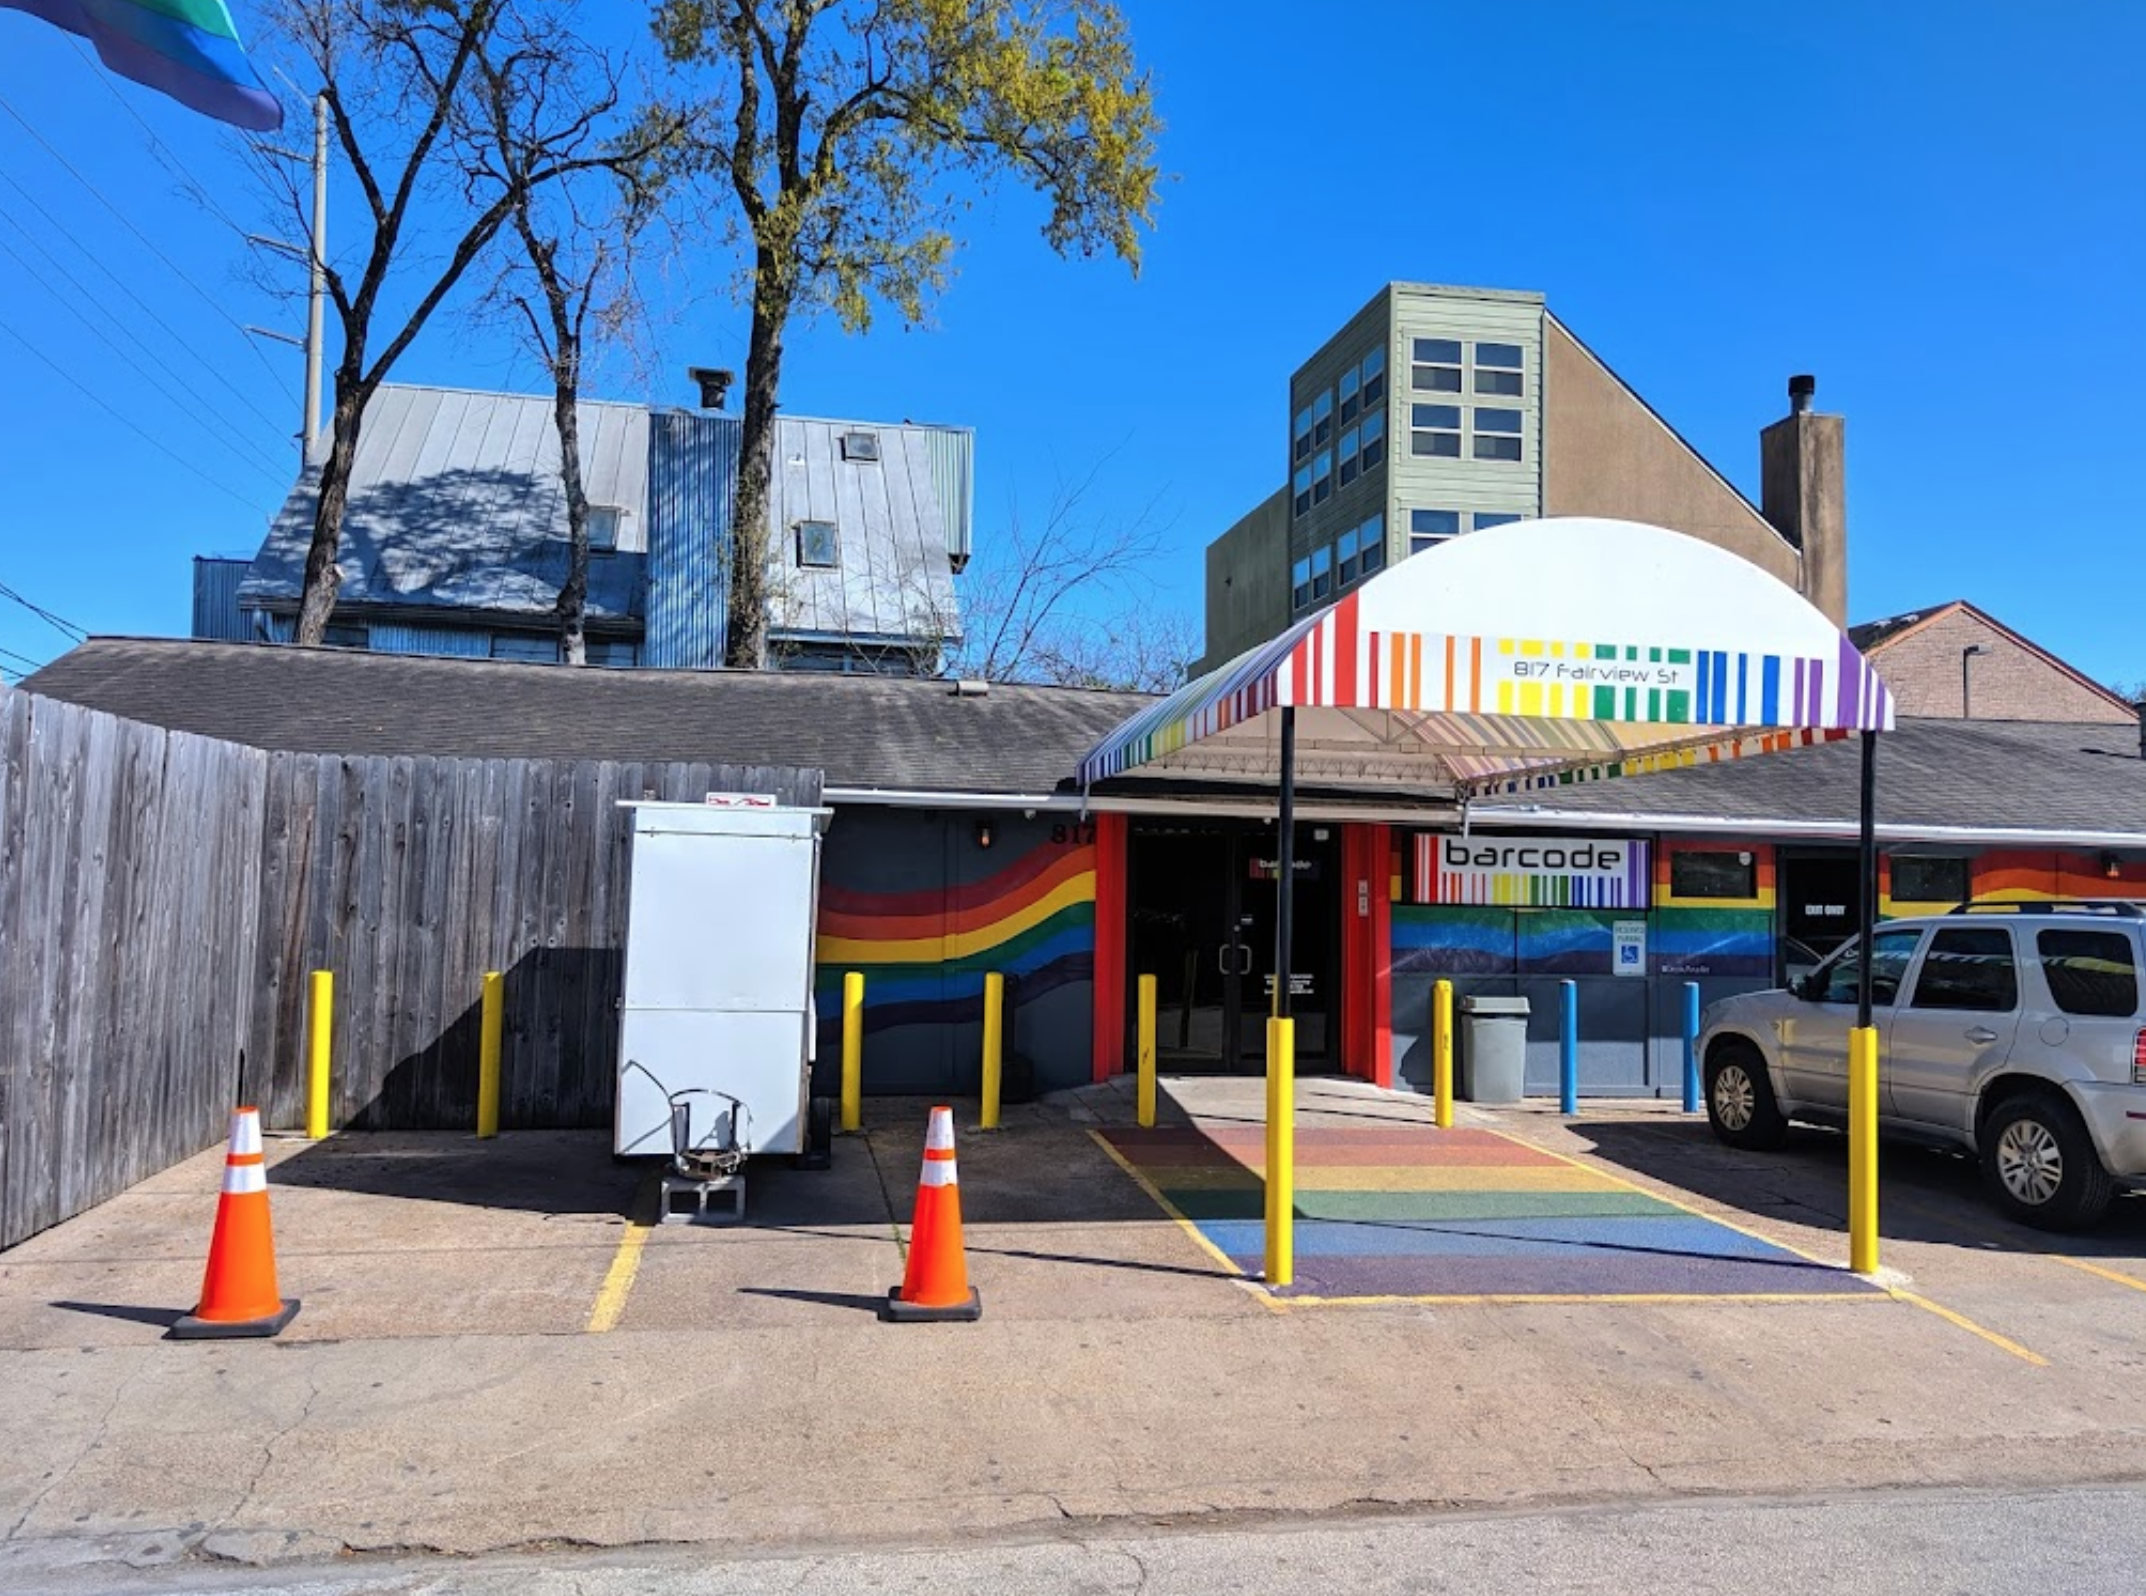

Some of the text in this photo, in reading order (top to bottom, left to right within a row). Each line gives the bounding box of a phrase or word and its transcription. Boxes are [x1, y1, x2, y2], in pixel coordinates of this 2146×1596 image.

[1513, 660, 1550, 677] 817
[1657, 668, 1679, 684] St
[1050, 823, 1096, 844] 817
[1445, 838, 1621, 870] barcode
